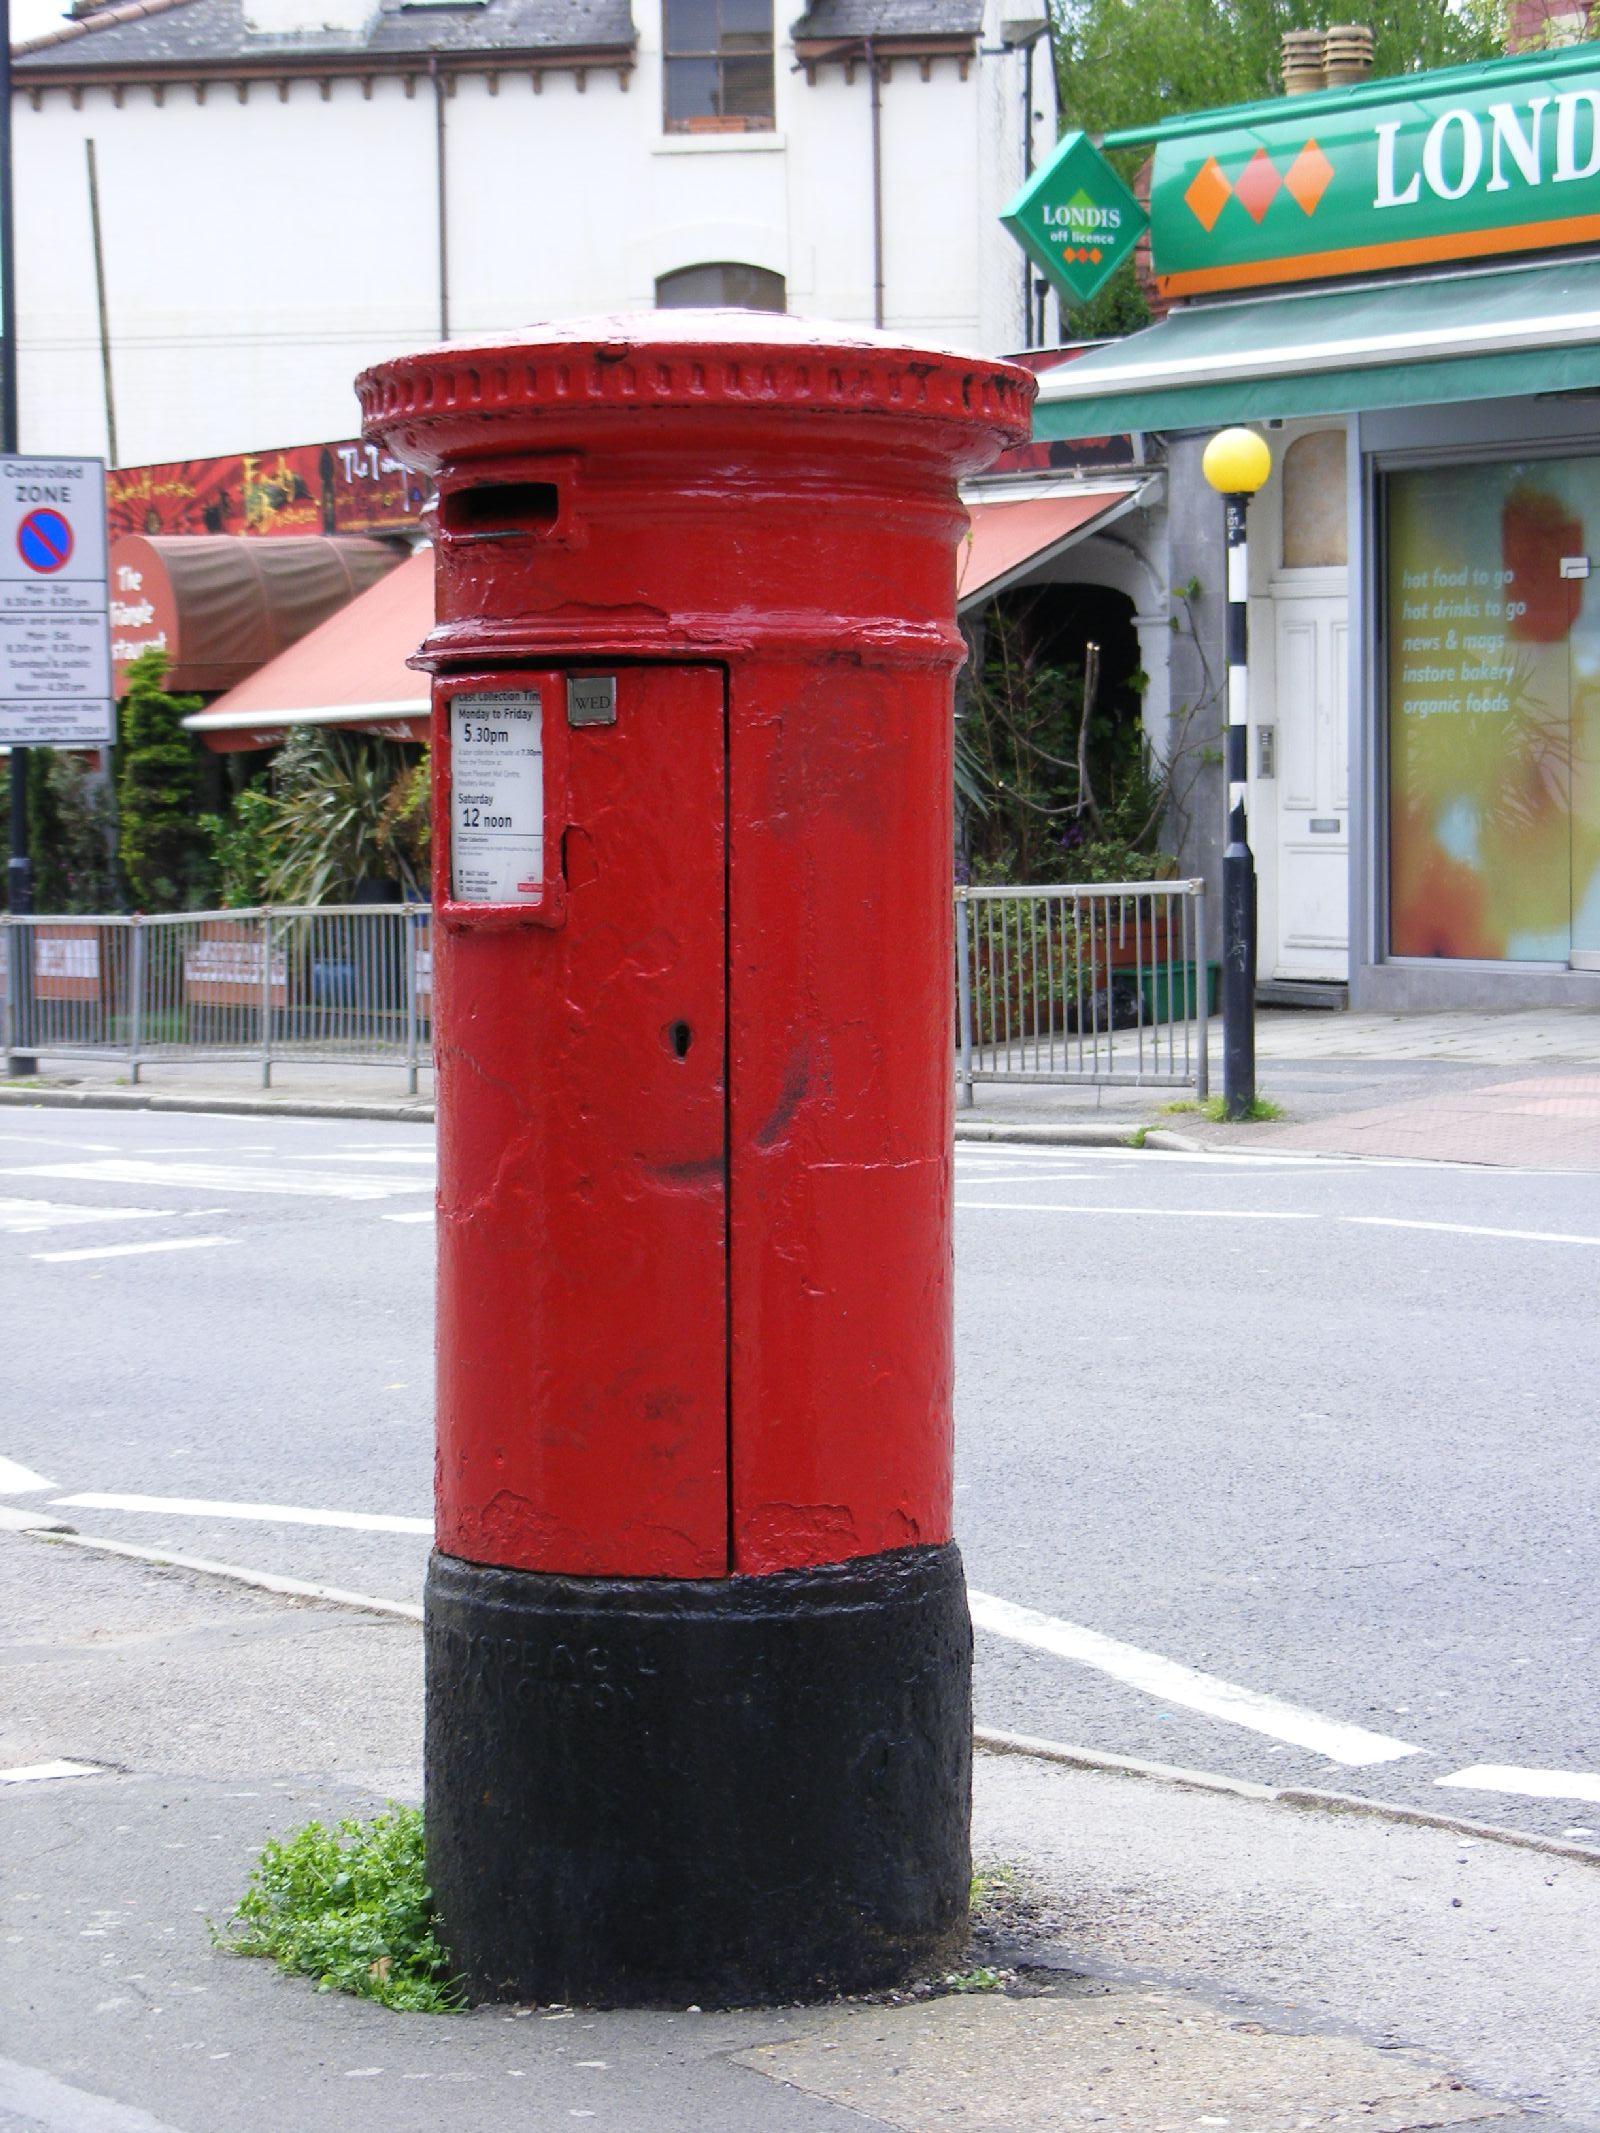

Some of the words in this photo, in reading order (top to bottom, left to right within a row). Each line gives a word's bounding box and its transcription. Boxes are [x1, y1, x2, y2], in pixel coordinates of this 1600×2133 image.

[1373, 89, 1600, 209] LOND
[1043, 205, 1120, 230] LONDIS
[1050, 231, 1068, 244] off
[1072, 231, 1115, 246] licence
[3, 463, 84, 479] Controlled
[15, 485, 72, 503] ZONE
[1403, 568, 1428, 589] hot
[1433, 565, 1468, 587] food
[1473, 567, 1489, 585] to
[1494, 568, 1515, 590] go
[1403, 600, 1428, 620] hot
[1433, 596, 1480, 618] drinks
[1485, 599, 1501, 617] to
[1506, 601, 1527, 621] go
[1403, 636, 1440, 652] news
[1445, 629, 1457, 650] &
[1463, 633, 1505, 654] mags
[1403, 663, 1456, 683] instore
[1461, 660, 1515, 685] bakery
[479, 691, 520, 703] Collection
[576, 697, 611, 710] WED
[1403, 693, 1460, 719] organic
[1466, 692, 1510, 712] foods
[458, 708, 490, 722] Monday
[493, 709, 502, 720] to
[504, 707, 533, 722] Friday
[464, 723, 509, 746] 5.30pm
[458, 793, 494, 807] Saturday
[462, 807, 480, 828] 12
[483, 815, 512, 828] noon
